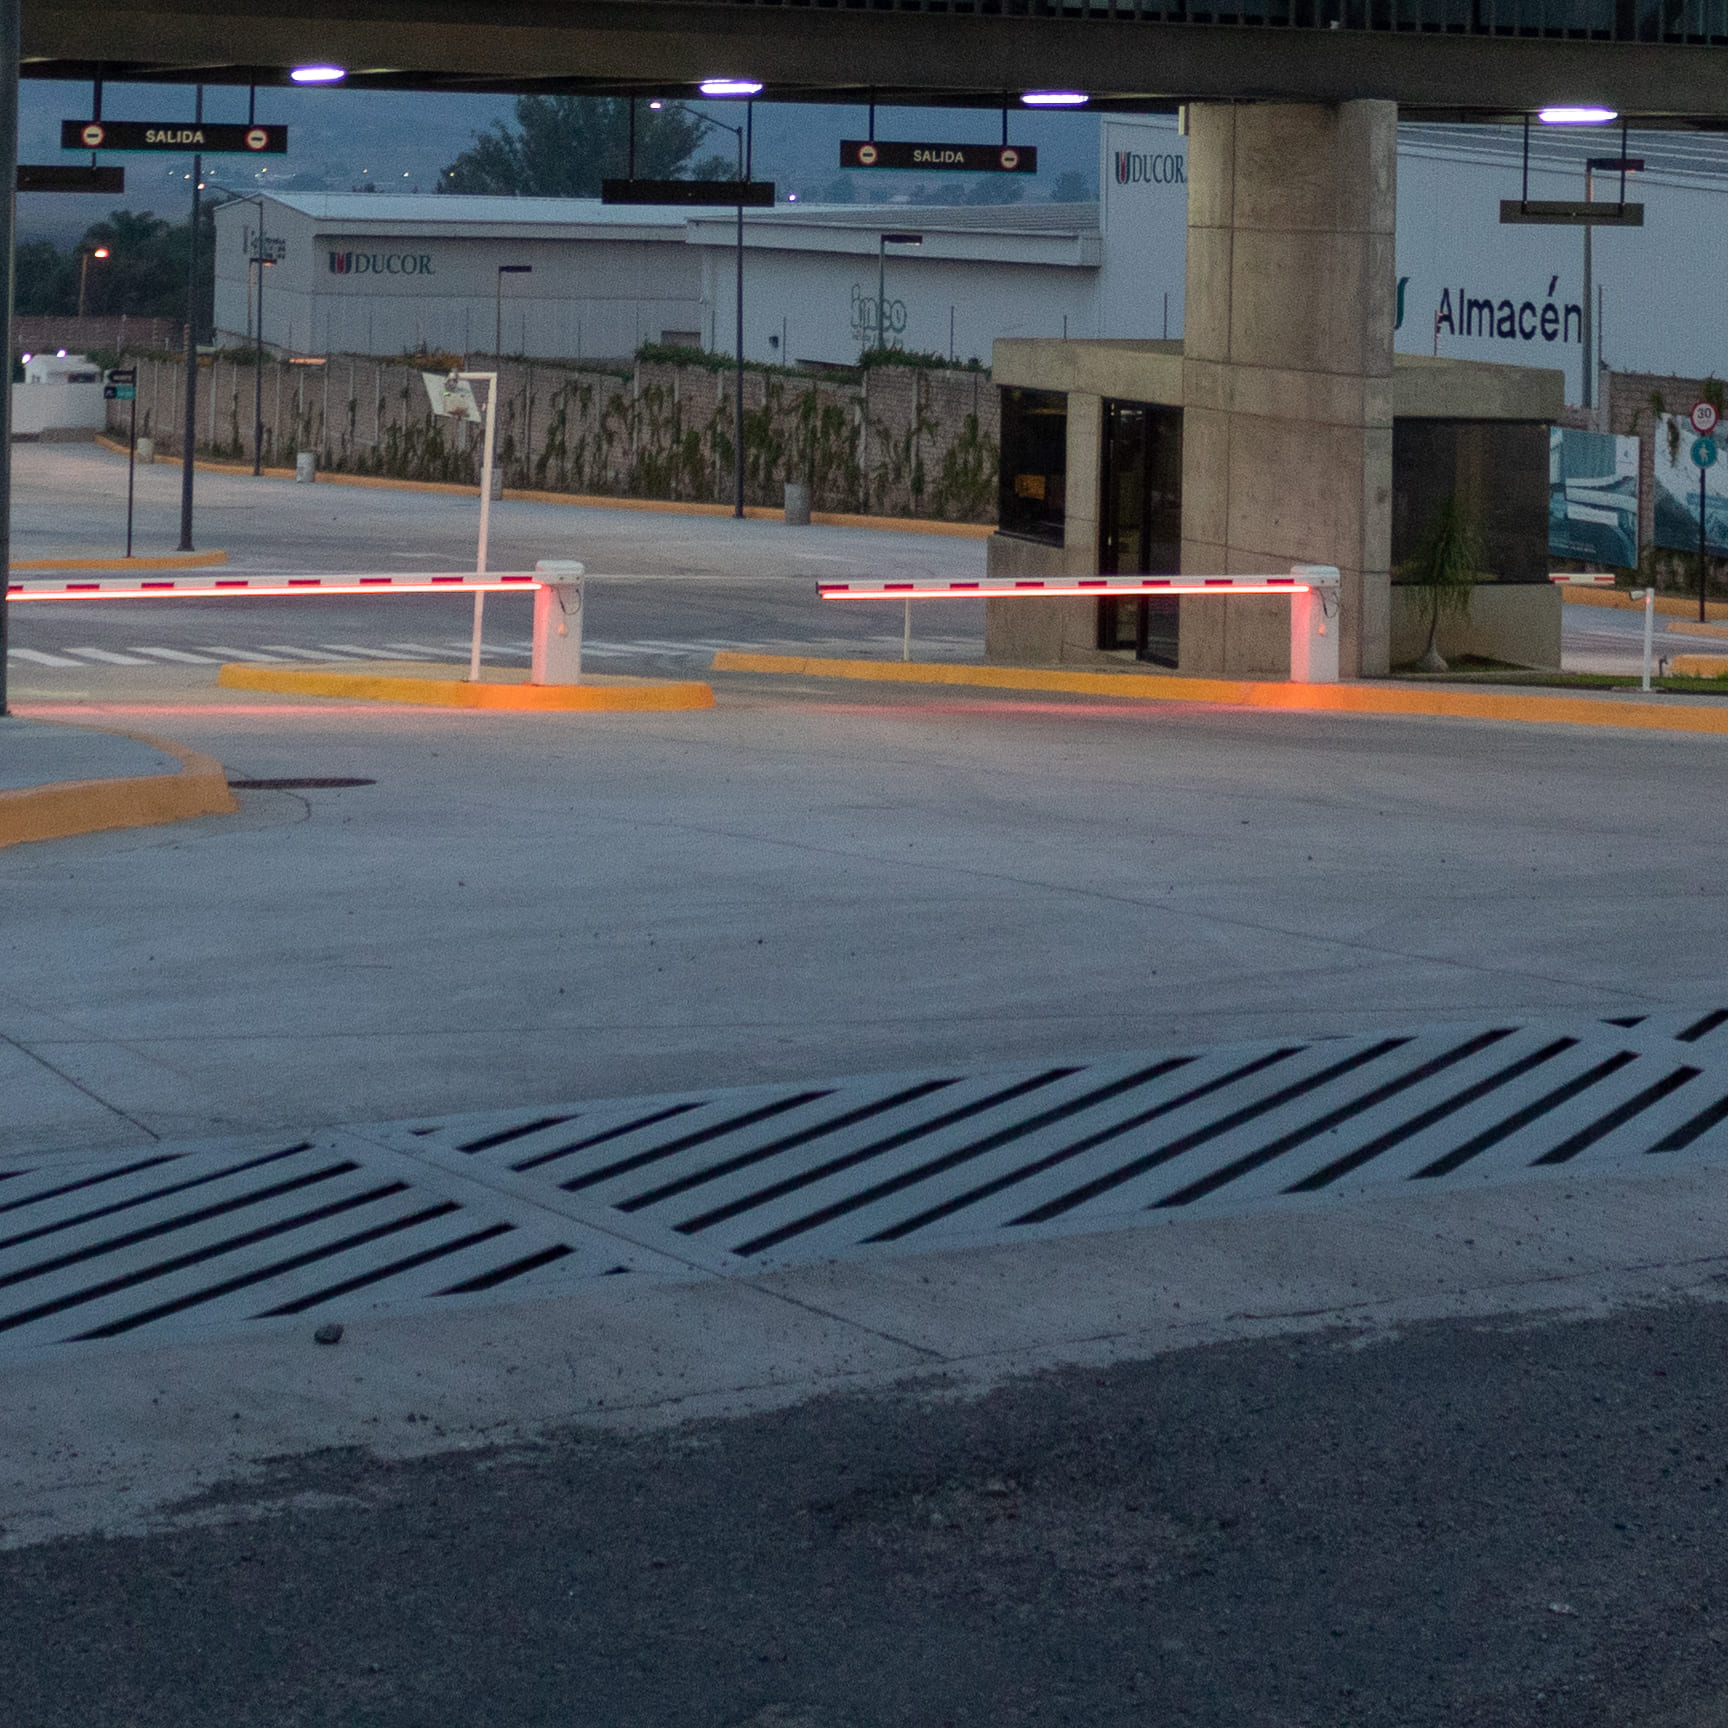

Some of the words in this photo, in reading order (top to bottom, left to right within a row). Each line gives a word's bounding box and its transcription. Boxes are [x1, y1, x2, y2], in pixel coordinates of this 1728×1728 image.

[145, 129, 205, 144] SALIDA
[912, 149, 965, 164] SALIDA
[1436, 275, 1582, 344] Almacén
[1697, 407, 1712, 419] 30
